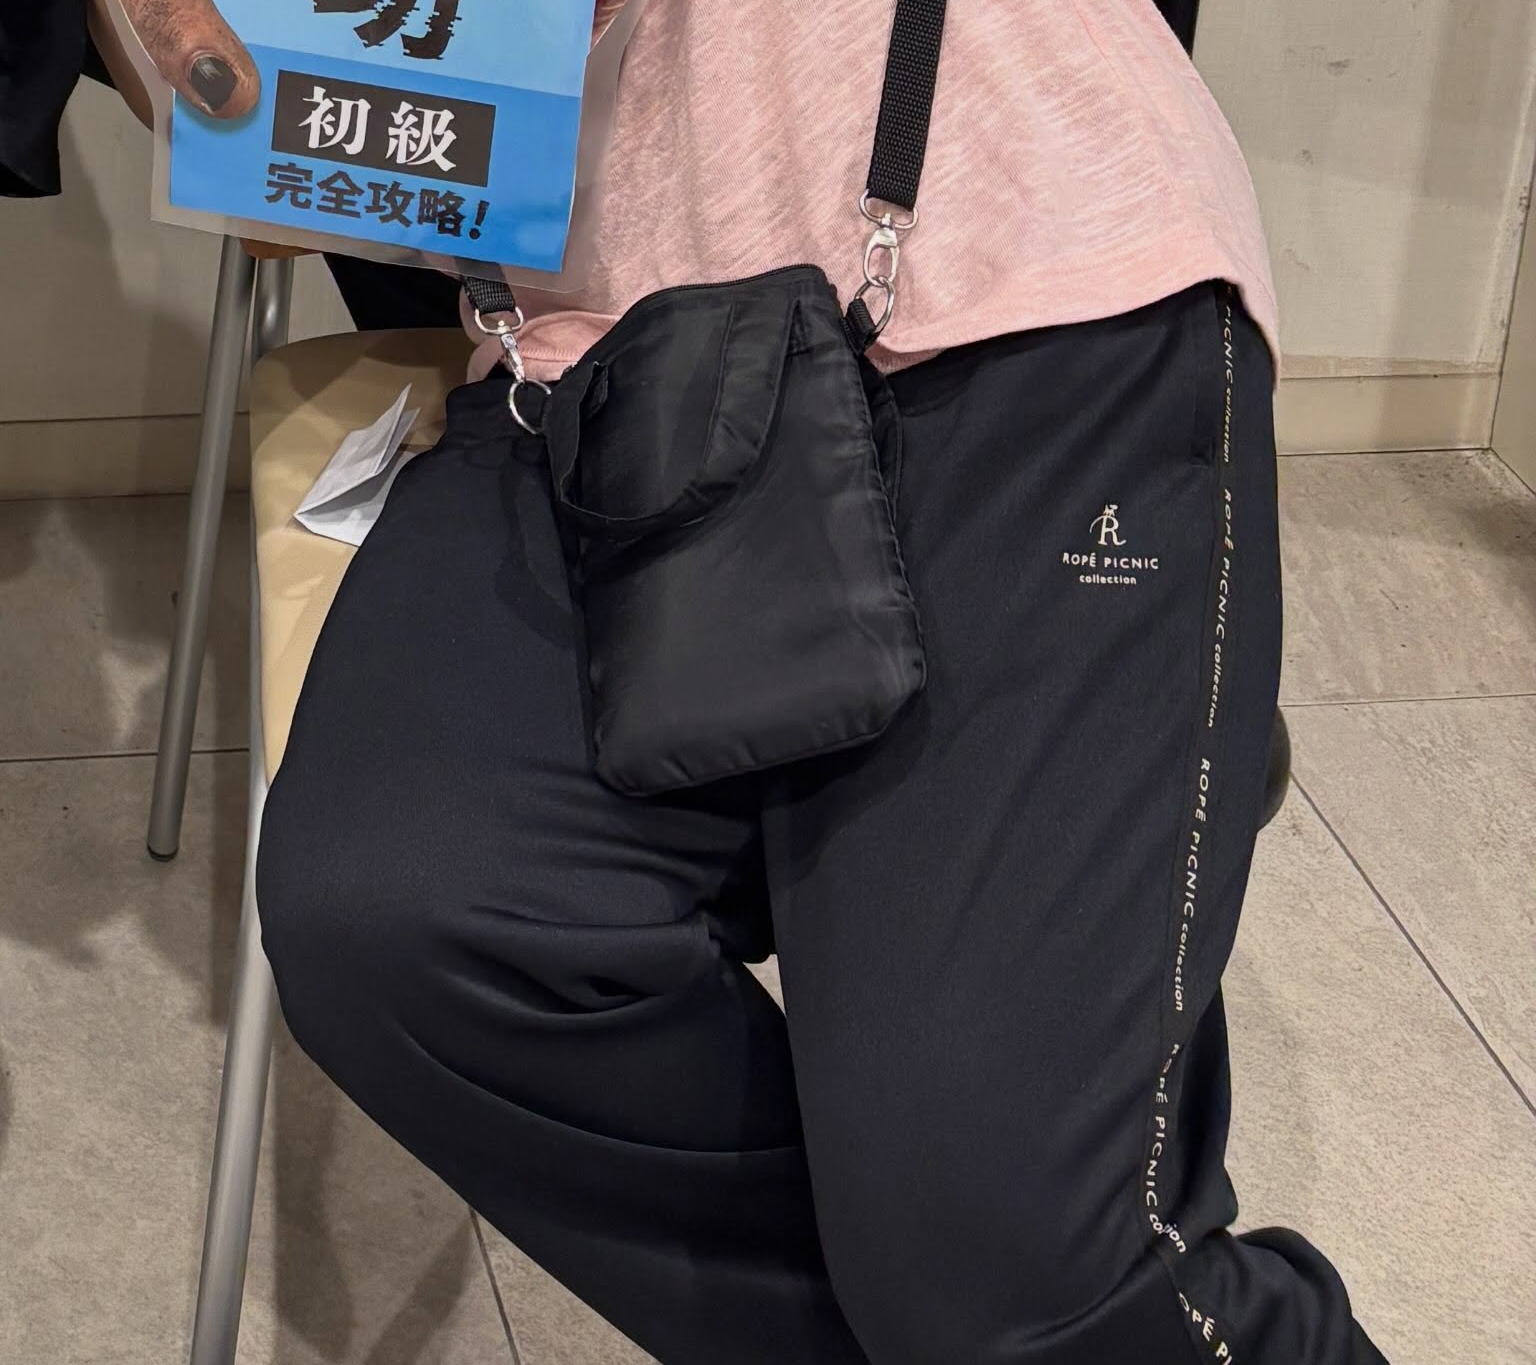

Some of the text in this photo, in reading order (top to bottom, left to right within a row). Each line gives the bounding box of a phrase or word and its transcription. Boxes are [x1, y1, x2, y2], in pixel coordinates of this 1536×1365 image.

[298, 86, 457, 173] 初級
[264, 162, 490, 240] 完全攻略!
[1063, 552, 1159, 570] ROPÉ PICNIC
[1079, 573, 1137, 585] collection
[1216, 556, 1230, 640] PICNIC
[1208, 643, 1222, 728] collection
[1175, 757, 1211, 1012] ROPÉ PICNIC collection
[1145, 1115, 1166, 1207] PICNIC
